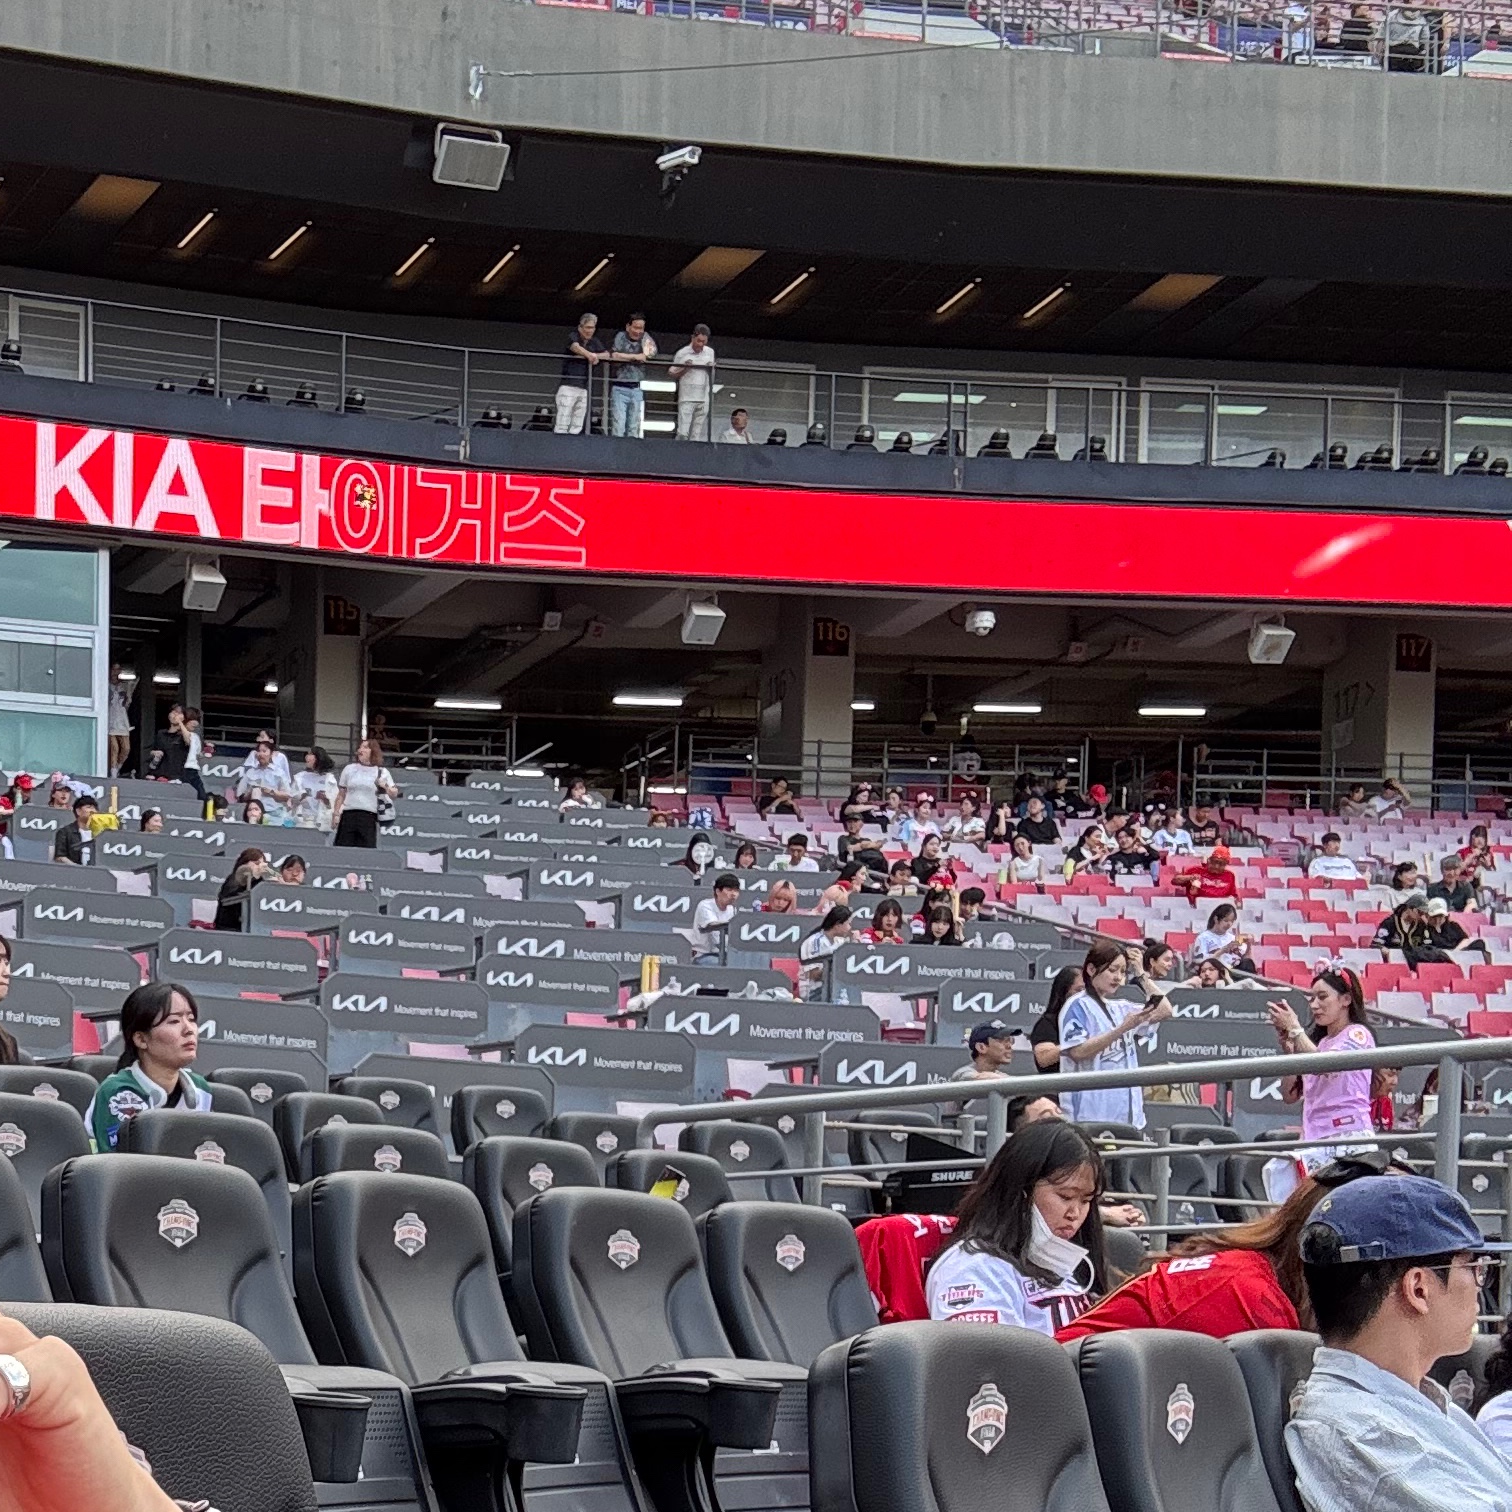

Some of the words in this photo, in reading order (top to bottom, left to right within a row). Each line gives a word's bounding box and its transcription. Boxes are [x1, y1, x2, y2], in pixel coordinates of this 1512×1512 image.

[35, 421, 222, 540] KIA
[242, 446, 587, 569] 타이거즈
[818, 622, 848, 641] 116
[1401, 639, 1429, 657] 117
[89, 914, 123, 927] Movement
[124, 918, 139, 927] that
[398, 938, 424, 950] Movement
[425, 941, 439, 951] that
[573, 949, 622, 962] Movement
[624, 951, 642, 963] that
[228, 957, 266, 970] Movement
[267, 959, 281, 970] that
[282, 961, 308, 973] inspires
[917, 965, 963, 979] Movement
[964, 967, 982, 979] that
[84, 974, 99, 987] that
[101, 977, 131, 991] inspires
[538, 979, 571, 991] Movement
[6, 1010, 24, 1023] that
[26, 1011, 61, 1027] inspires
[394, 1004, 432, 1018] Movement
[433, 1006, 448, 1018] that
[449, 1008, 478, 1020] inspires
[223, 1029, 268, 1046] Movement
[269, 1032, 285, 1046] that
[286, 1035, 317, 1050] inspires
[750, 1025, 803, 1041] Movement
[805, 1027, 825, 1041] that
[826, 1028, 864, 1043] inspires
[1167, 1042, 1218, 1056] Movement
[1220, 1044, 1240, 1056] that
[594, 1057, 635, 1070] Movement
[636, 1058, 653, 1071] that
[654, 1060, 683, 1073] inspires
[931, 1170, 974, 1183] SHURE
